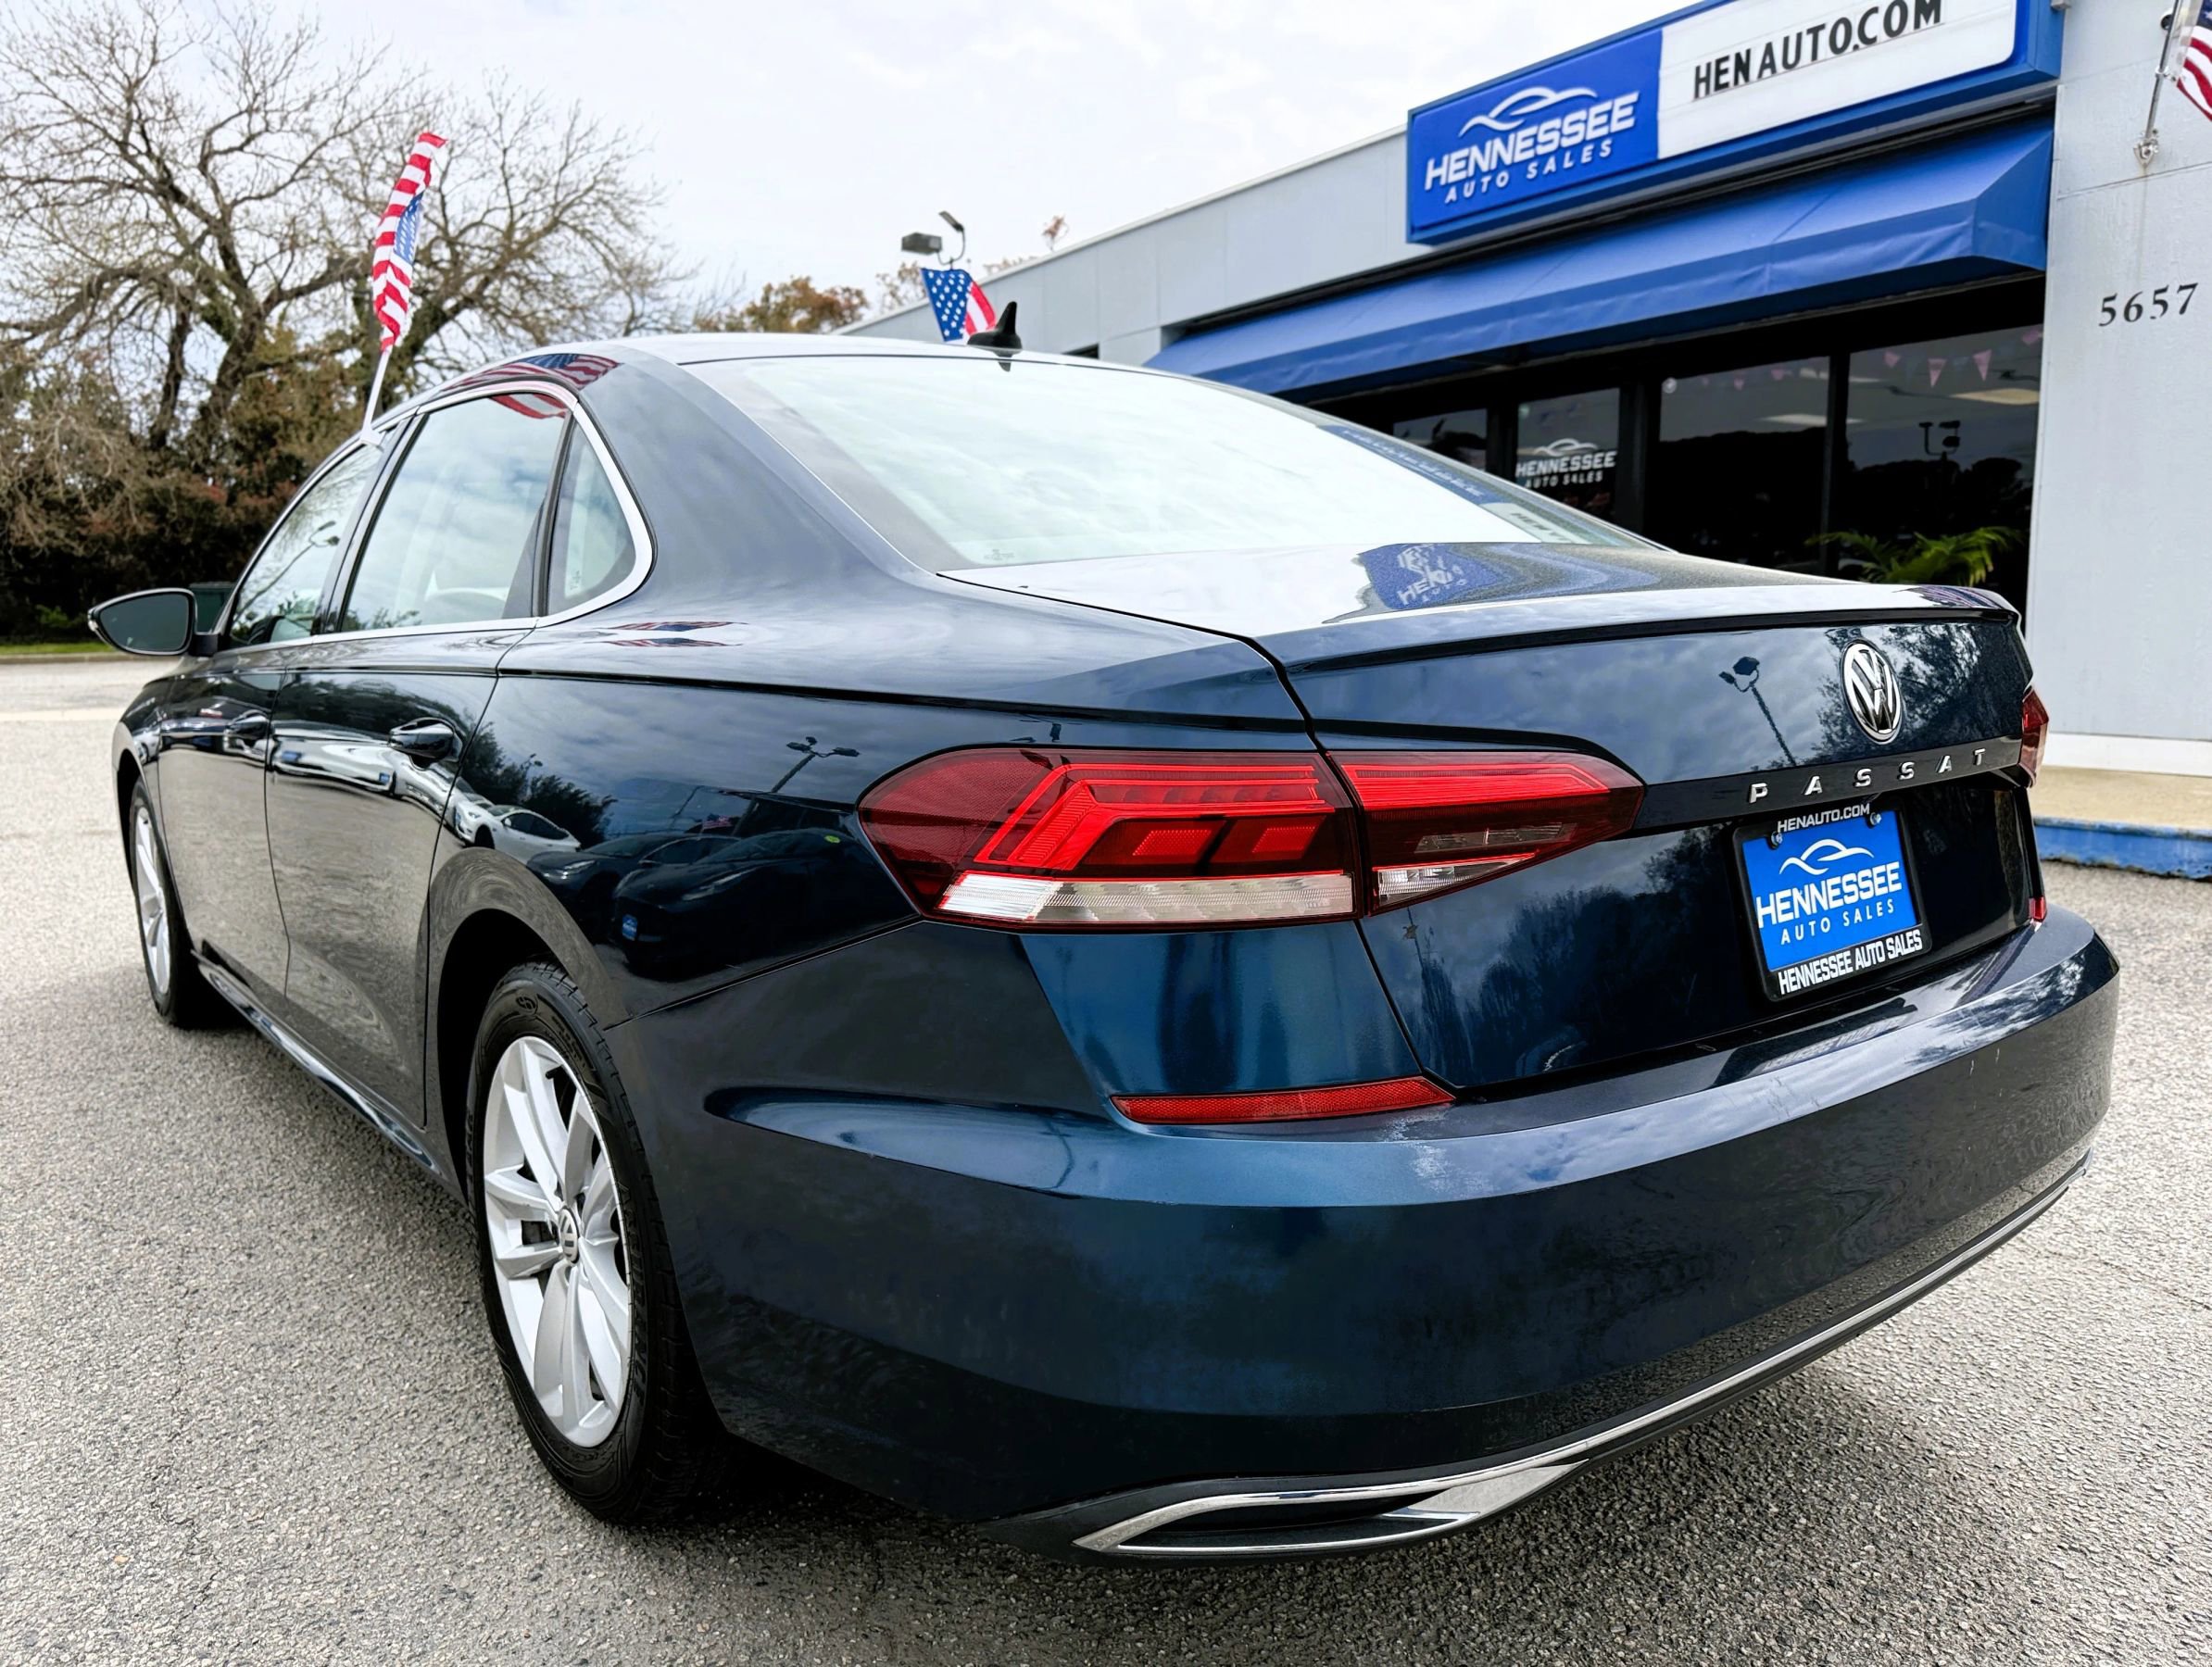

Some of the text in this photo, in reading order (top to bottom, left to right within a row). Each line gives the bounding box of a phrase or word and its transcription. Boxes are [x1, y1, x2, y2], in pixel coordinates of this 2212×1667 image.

[1425, 91, 1640, 191] HENNESSEE
[1444, 139, 1613, 204] AUTO SALES
[2098, 282, 2198, 327] 5657
[1515, 451, 1617, 478] HENNESSEE
[1526, 470, 1603, 489] AUTO SALES
[1749, 748, 1986, 804] PASSAT
[1777, 803, 1870, 834] HENAUTO.COM
[1755, 861, 1902, 929] HENNESSEE
[1780, 898, 1894, 946] AUTO SALES
[1778, 929, 1923, 996] HENNESSEE AUTO SALES
